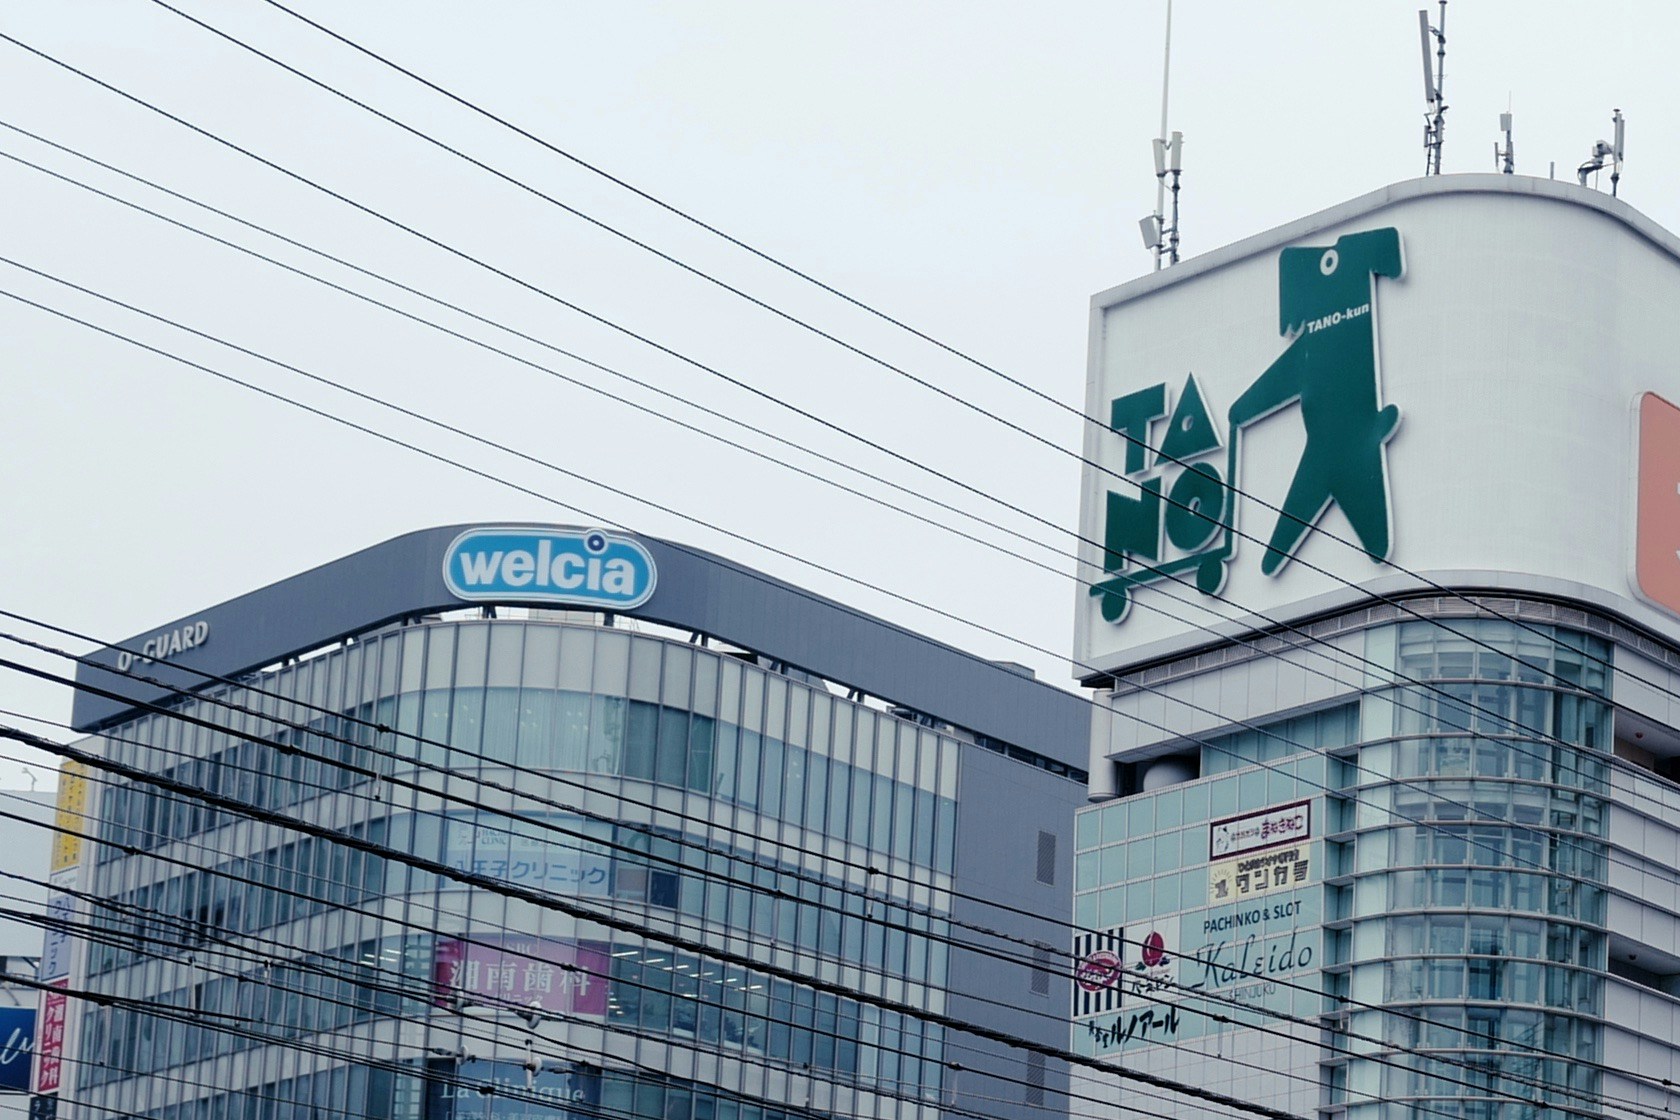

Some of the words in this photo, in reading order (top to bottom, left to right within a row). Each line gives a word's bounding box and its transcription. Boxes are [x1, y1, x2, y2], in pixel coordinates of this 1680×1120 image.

[1306, 303, 1370, 334] TANO-kun
[459, 530, 637, 595] welcia
[117, 619, 210, 672] O-GUARD
[1235, 860, 1309, 894] ワンカラ
[1203, 909, 1261, 935] PACHINKO
[1262, 908, 1271, 921] &
[1273, 900, 1302, 919] SLOT
[1189, 925, 1313, 988] Kaleido
